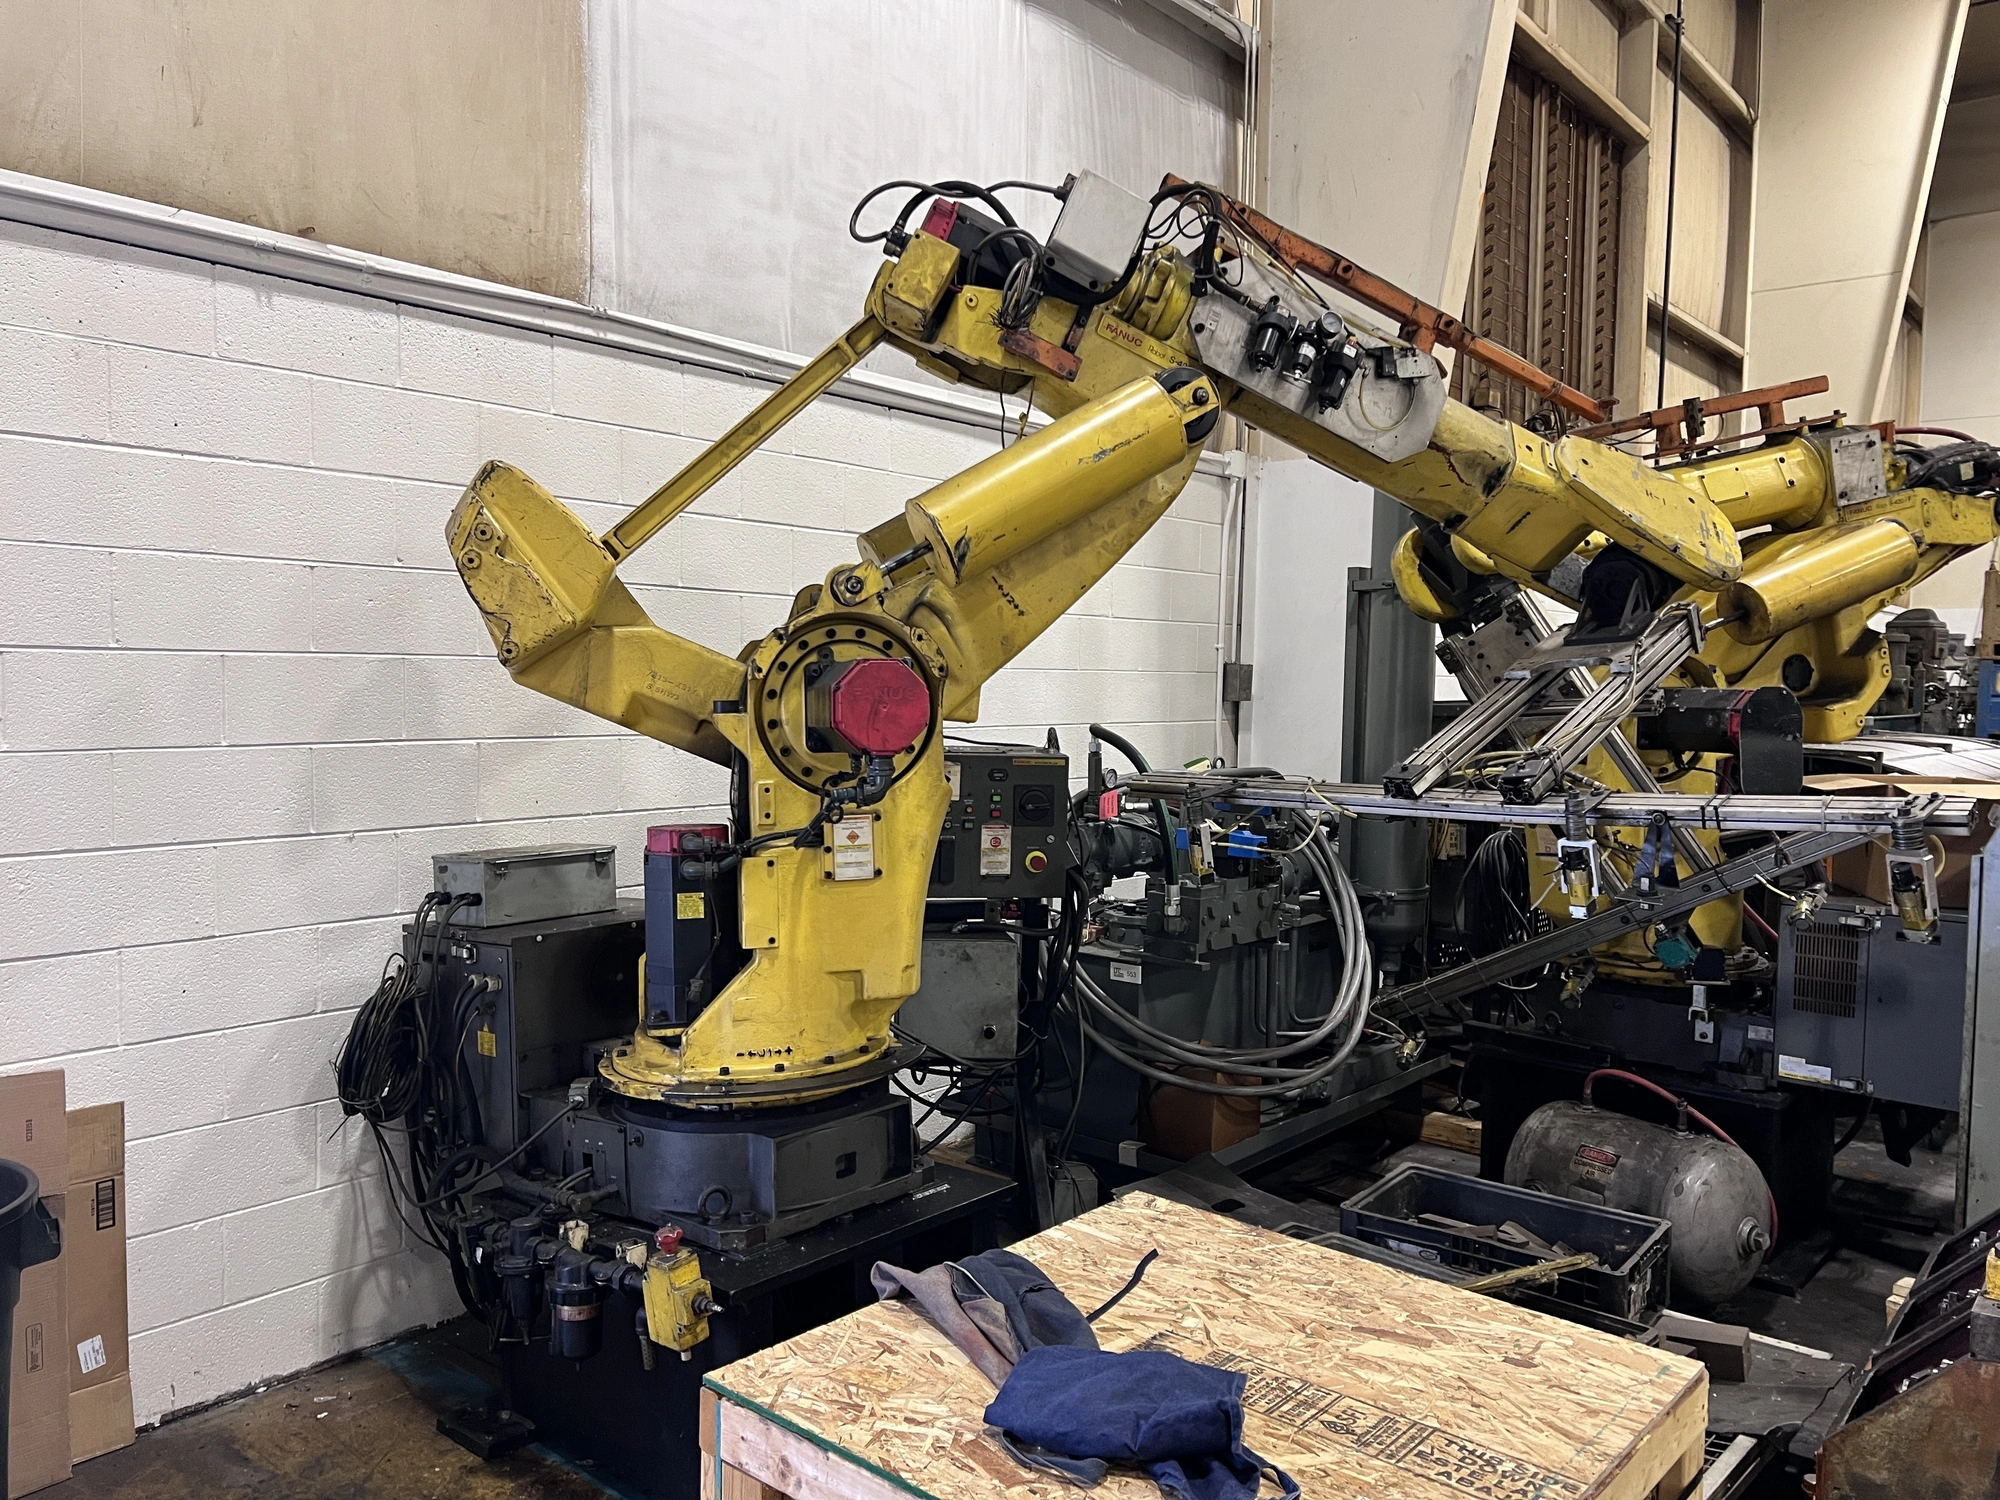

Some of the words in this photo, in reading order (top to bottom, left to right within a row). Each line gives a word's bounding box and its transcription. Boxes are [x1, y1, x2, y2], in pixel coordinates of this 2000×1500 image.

[1105, 323, 1143, 347] FANUC
[1148, 344, 1166, 359] Robot
[1849, 506, 1872, 516] FANUC
[1127, 970, 1137, 978] 553
[1584, 1149, 1613, 1161] DANGER
[1574, 1159, 1613, 1175] COMPRESSED
[1586, 1169, 1596, 1177] AIR
[1414, 1450, 1486, 1481] ESTE
[1445, 1438, 1504, 1466] THIS
[1512, 1463, 1580, 1494] SIDE
[1458, 1455, 1545, 1493] DOWN
